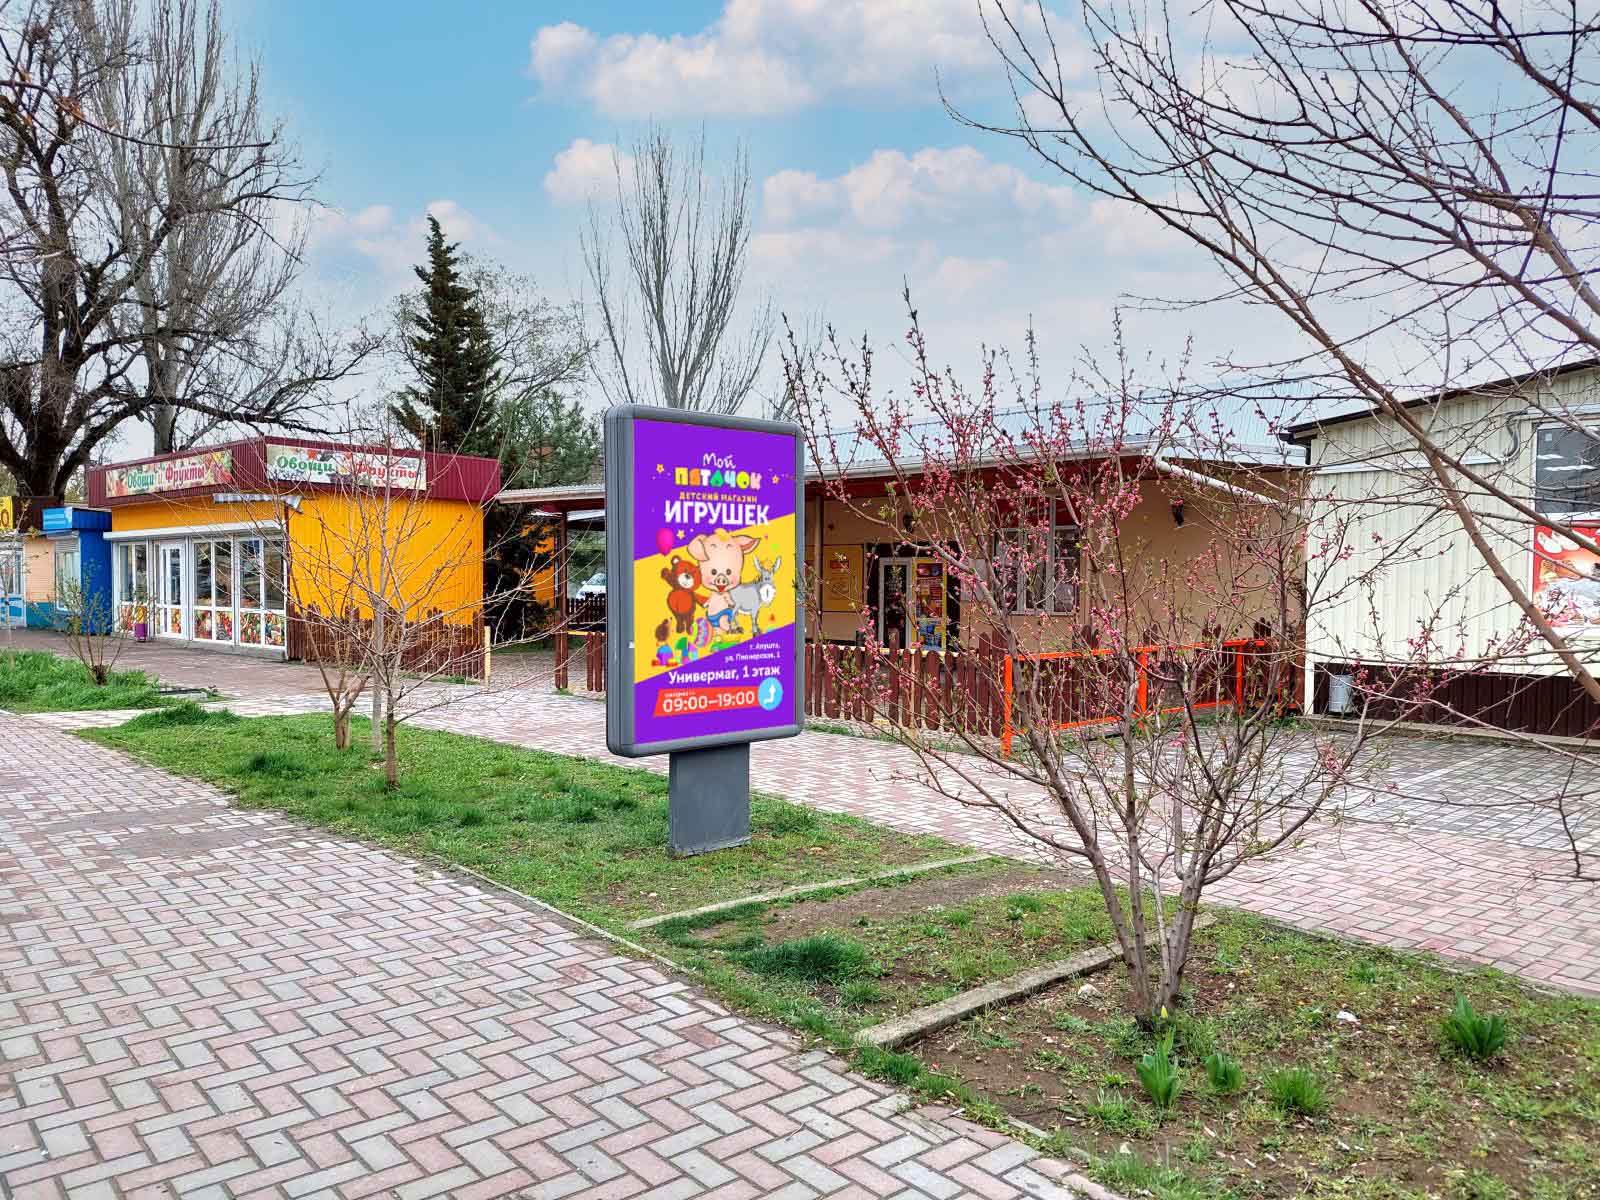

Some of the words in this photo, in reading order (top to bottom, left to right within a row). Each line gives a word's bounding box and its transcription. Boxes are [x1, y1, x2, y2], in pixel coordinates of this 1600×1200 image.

[276, 455, 335, 475] Овощи
[702, 452, 736, 469] Мой
[127, 471, 155, 491] Овощи
[165, 463, 206, 487] Фрукты
[679, 492, 719, 501] ДЕТСКИЙ
[664, 500, 770, 526] ИГРУШЕК
[668, 669, 739, 685] Универмаг,
[742, 664, 750, 678] 1
[751, 665, 781, 678] этаж
